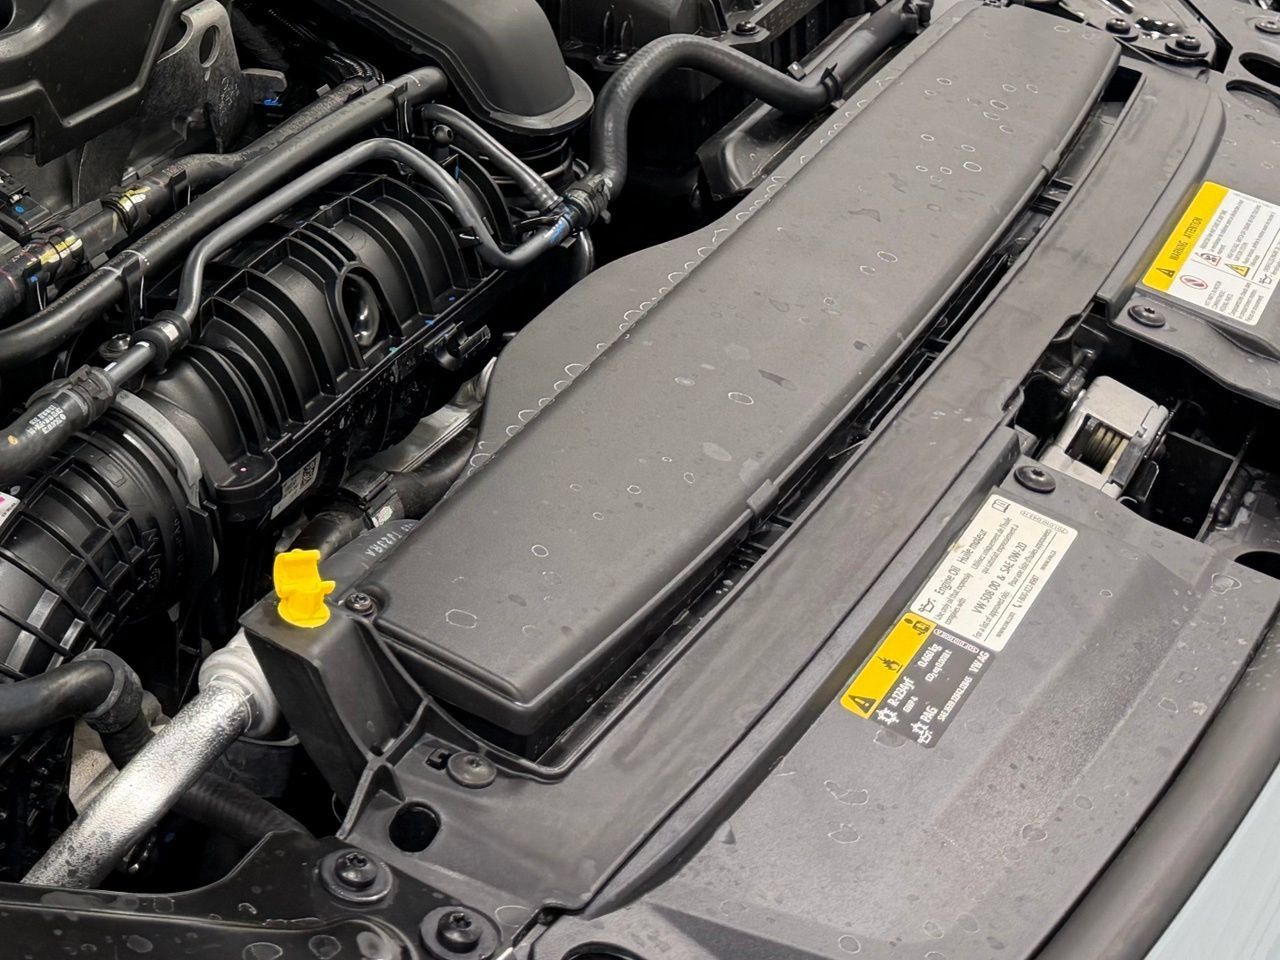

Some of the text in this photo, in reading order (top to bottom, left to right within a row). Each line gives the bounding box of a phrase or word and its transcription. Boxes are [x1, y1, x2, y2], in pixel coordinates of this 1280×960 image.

[1170, 217, 1202, 261] WARNING ATTENTION
[957, 529, 986, 563] Huile moteur
[935, 574, 956, 595] Engine
[972, 601, 986, 614] VW
[980, 589, 994, 601] 508
[1000, 561, 1013, 574] SAE
[888, 677, 916, 707] R-1234yf
[920, 706, 937, 722] PAG
